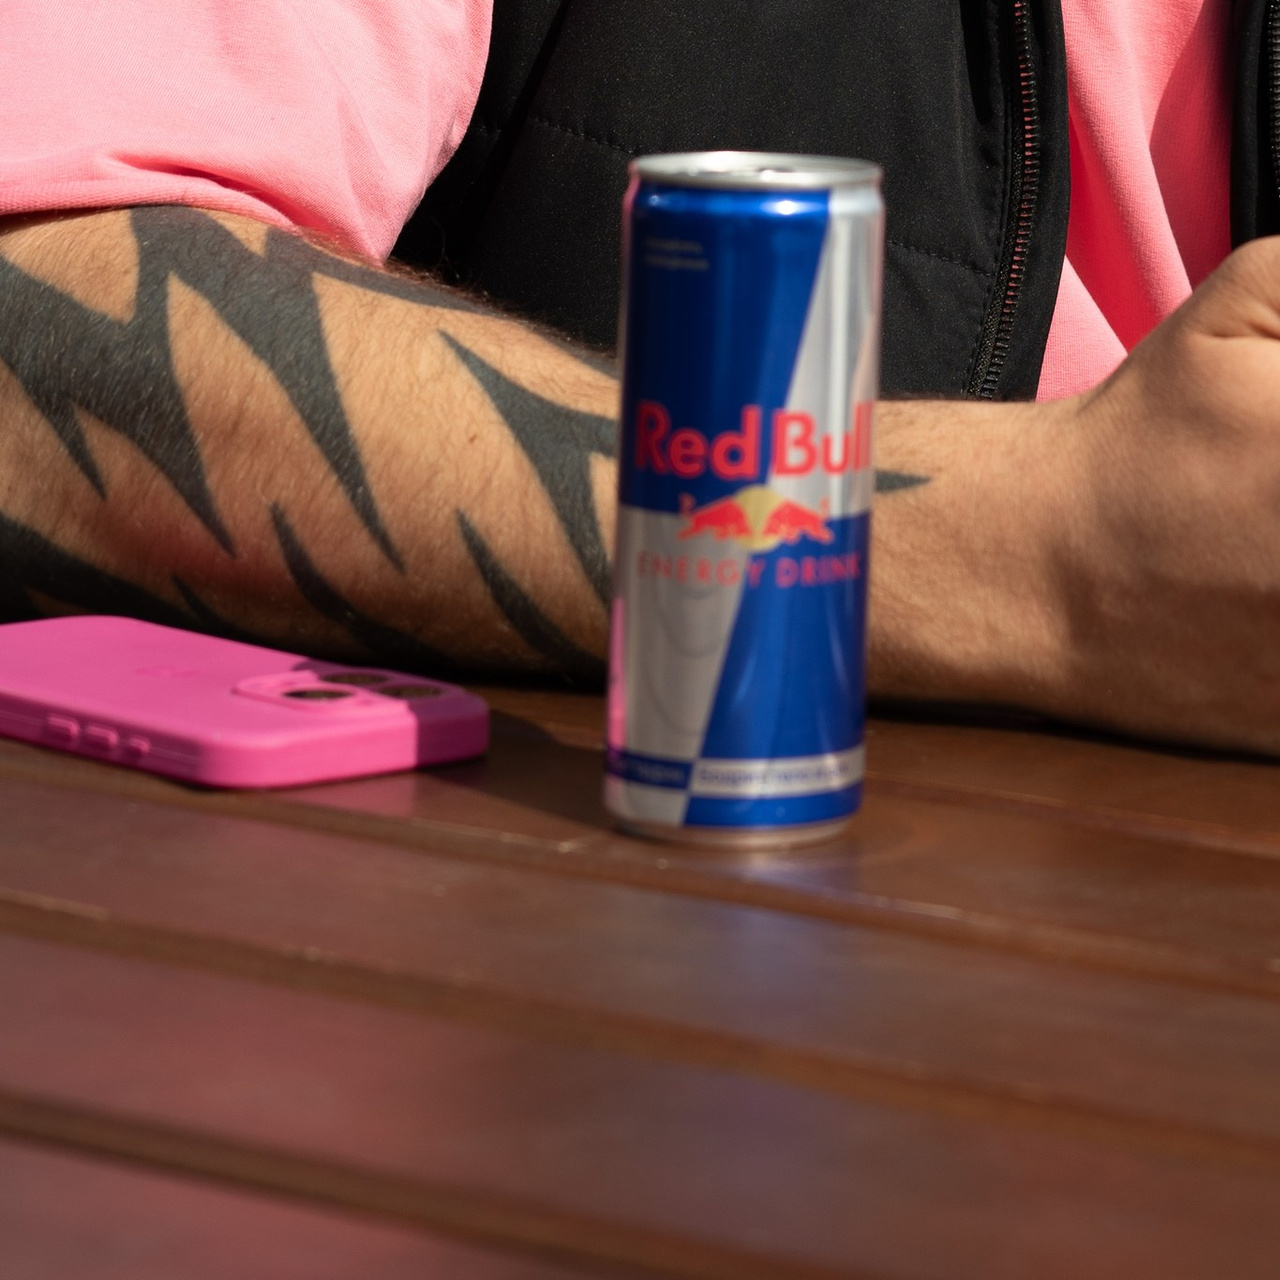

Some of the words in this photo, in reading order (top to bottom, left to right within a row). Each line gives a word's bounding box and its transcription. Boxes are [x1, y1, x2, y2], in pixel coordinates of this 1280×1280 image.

[634, 401, 762, 482] Red
[637, 550, 766, 587] ENERGY
[774, 552, 861, 588] DRINK
